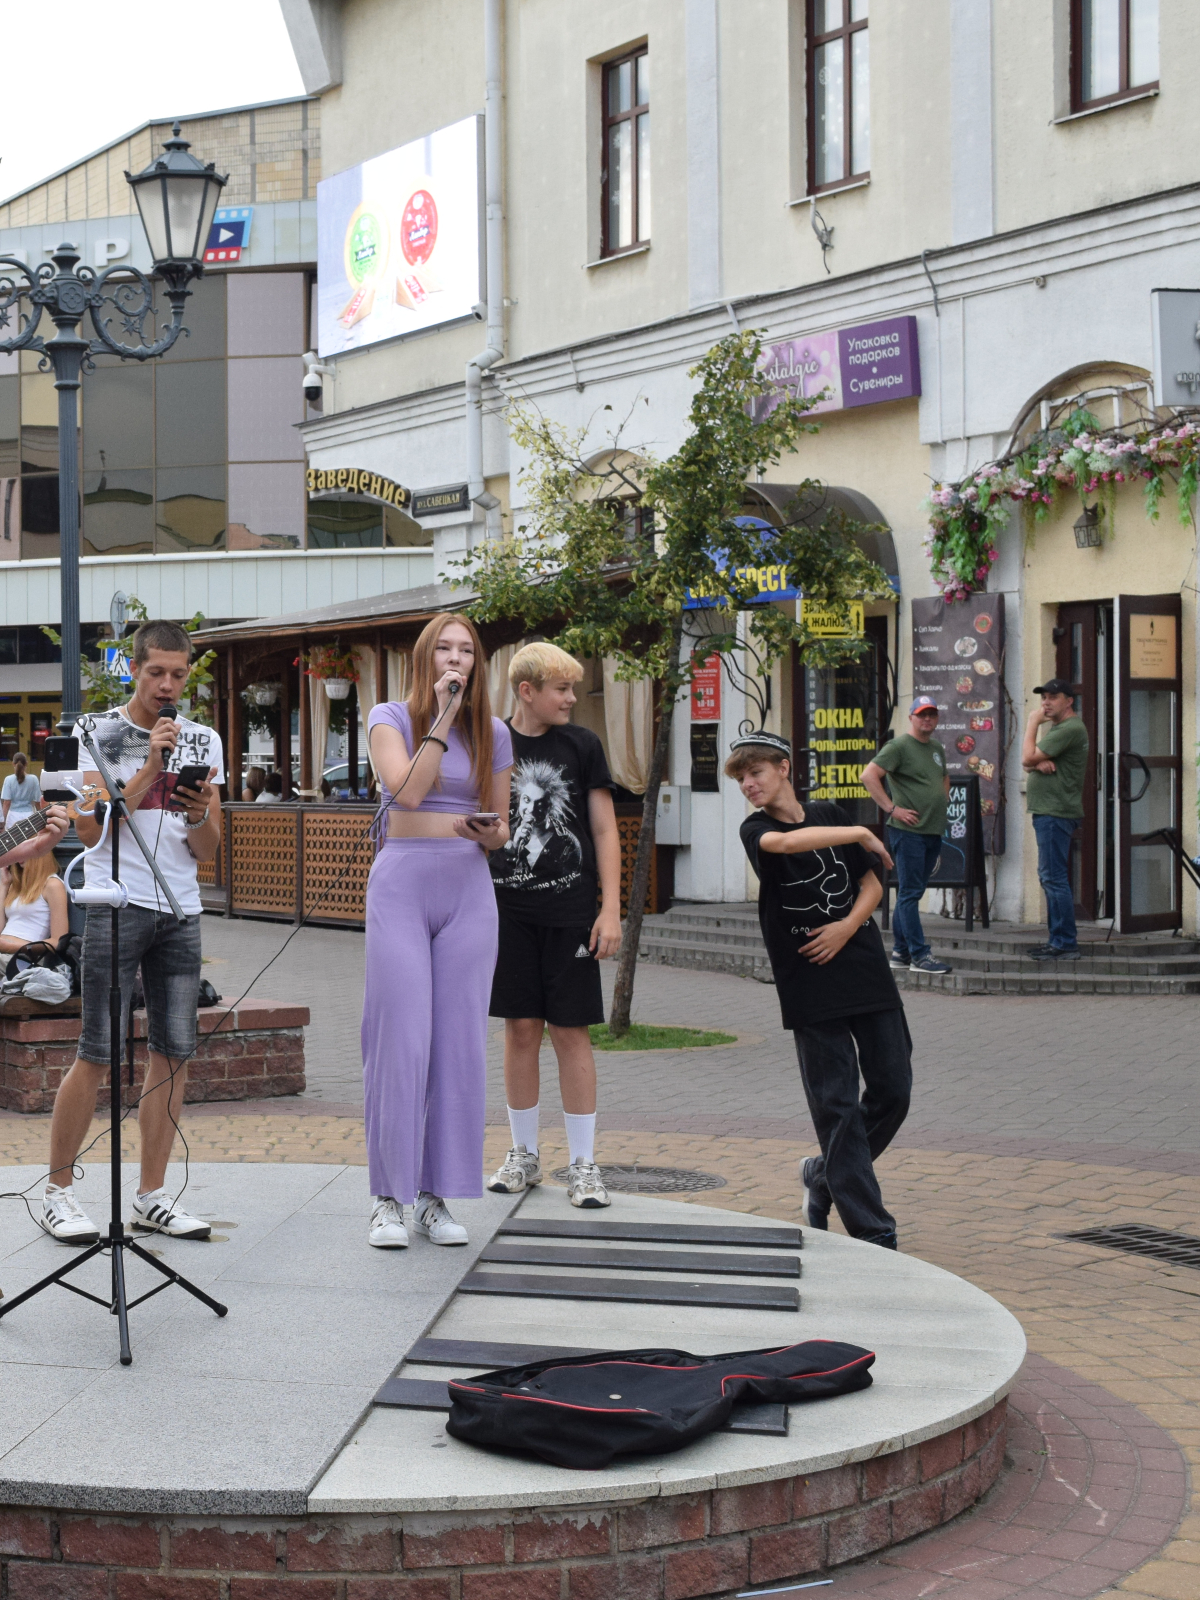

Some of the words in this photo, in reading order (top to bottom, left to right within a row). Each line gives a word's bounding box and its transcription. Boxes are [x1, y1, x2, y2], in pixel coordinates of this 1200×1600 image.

[847, 332, 900, 352] Упаковка
[848, 346, 901, 366] подарков
[752, 347, 819, 399] ostalgie
[849, 374, 904, 393] Сувениры
[814, 708, 864, 729] ОКНА
[809, 739, 876, 753] РОЛЬШТОРЫ
[809, 786, 872, 799] МОСКИТНЫ
